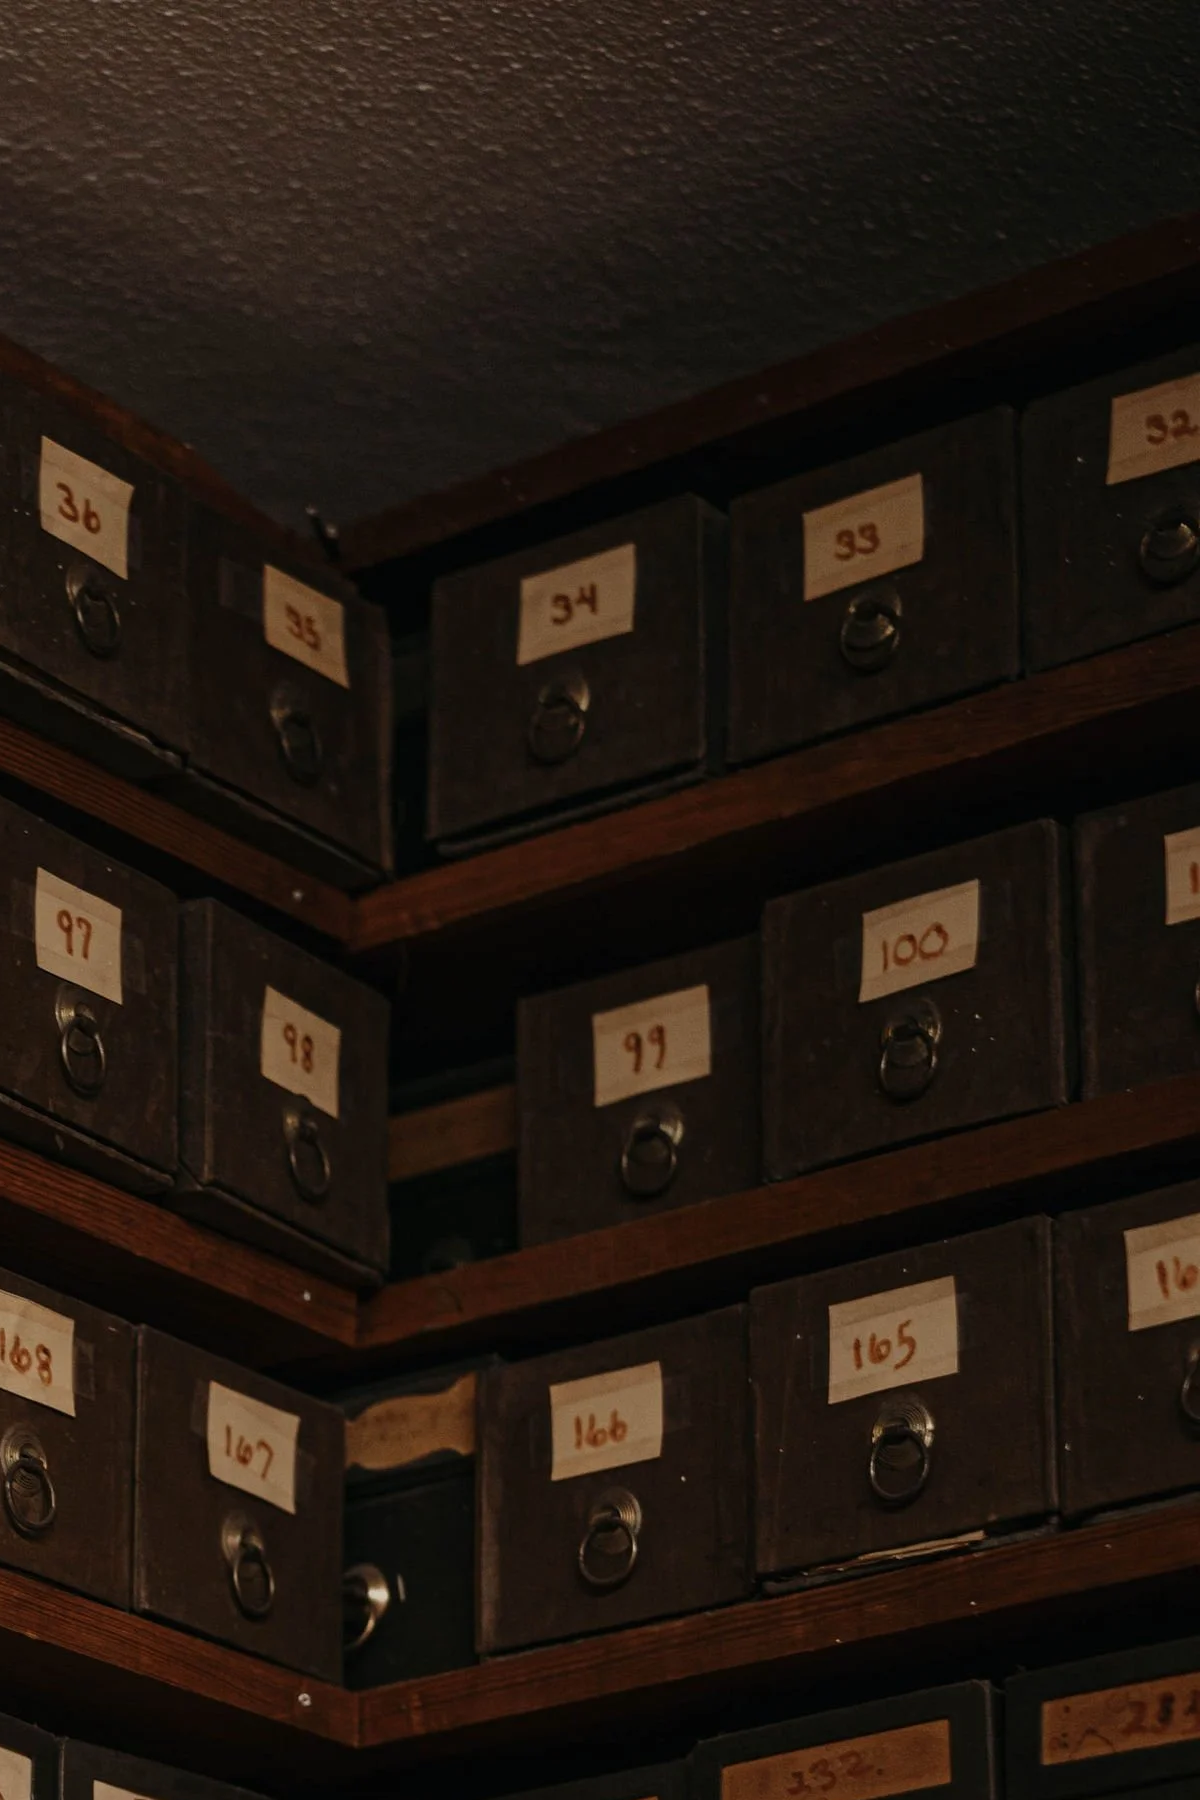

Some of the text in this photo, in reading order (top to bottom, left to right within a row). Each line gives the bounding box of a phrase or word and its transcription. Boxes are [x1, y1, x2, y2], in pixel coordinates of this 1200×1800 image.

[1145, 409, 1200, 444] 32
[56, 482, 101, 534] 36
[834, 522, 880, 560] 33
[285, 604, 319, 652] 35
[550, 582, 598, 626] 34
[56, 909, 92, 959] 97
[881, 922, 949, 971] 100
[282, 1022, 314, 1074] 98
[623, 1024, 666, 1074] 99
[0, 1328, 53, 1387] 168
[852, 1320, 917, 1370] 165
[224, 1424, 274, 1480] 167
[573, 1409, 628, 1450] 166
